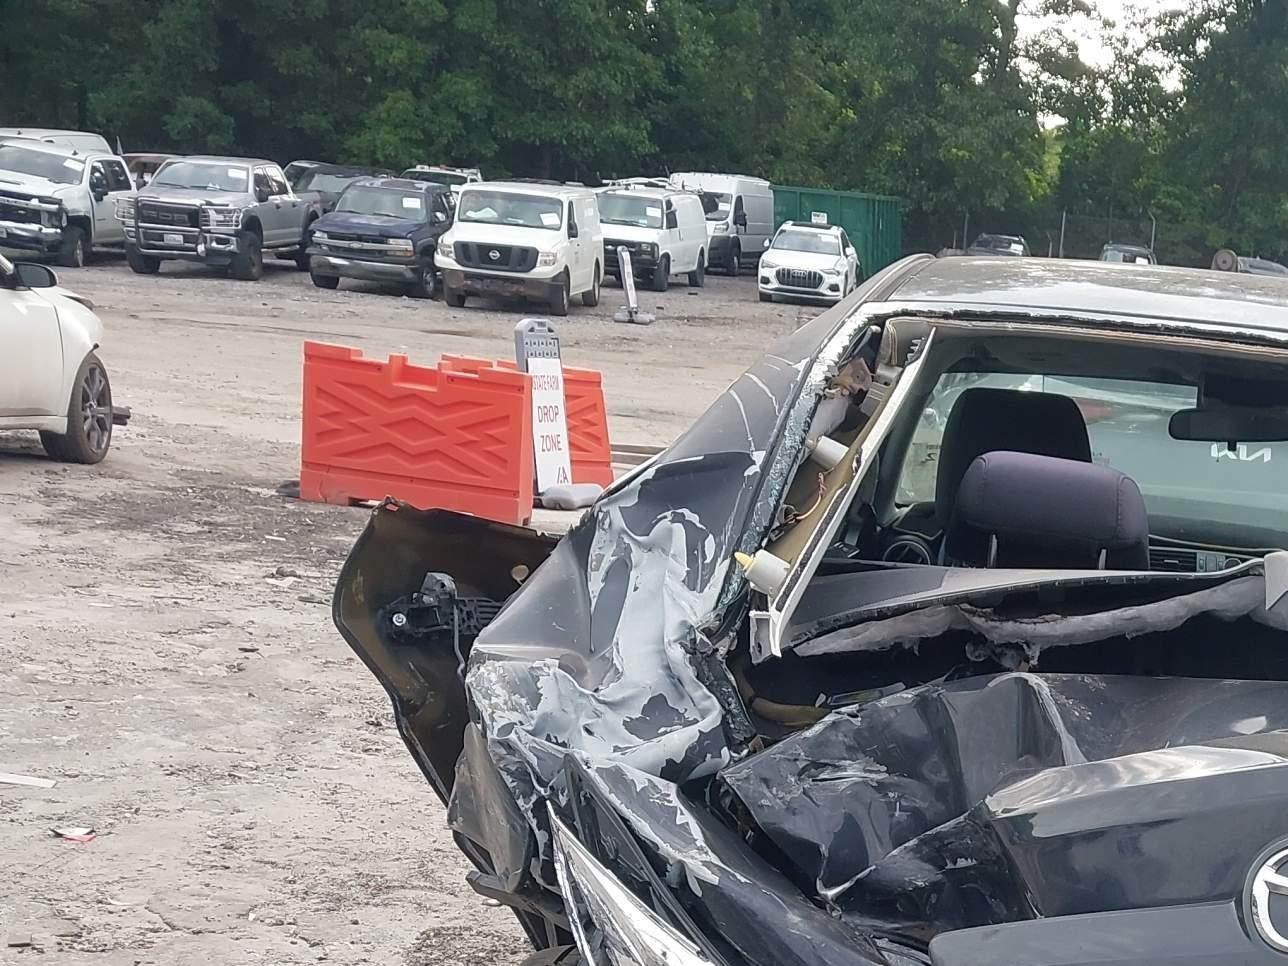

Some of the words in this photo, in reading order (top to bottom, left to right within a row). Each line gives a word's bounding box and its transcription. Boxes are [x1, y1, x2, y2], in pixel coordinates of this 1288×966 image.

[537, 405, 559, 423] DROP
[540, 434, 562, 452] ZONE
[1210, 442, 1272, 463] KIA
